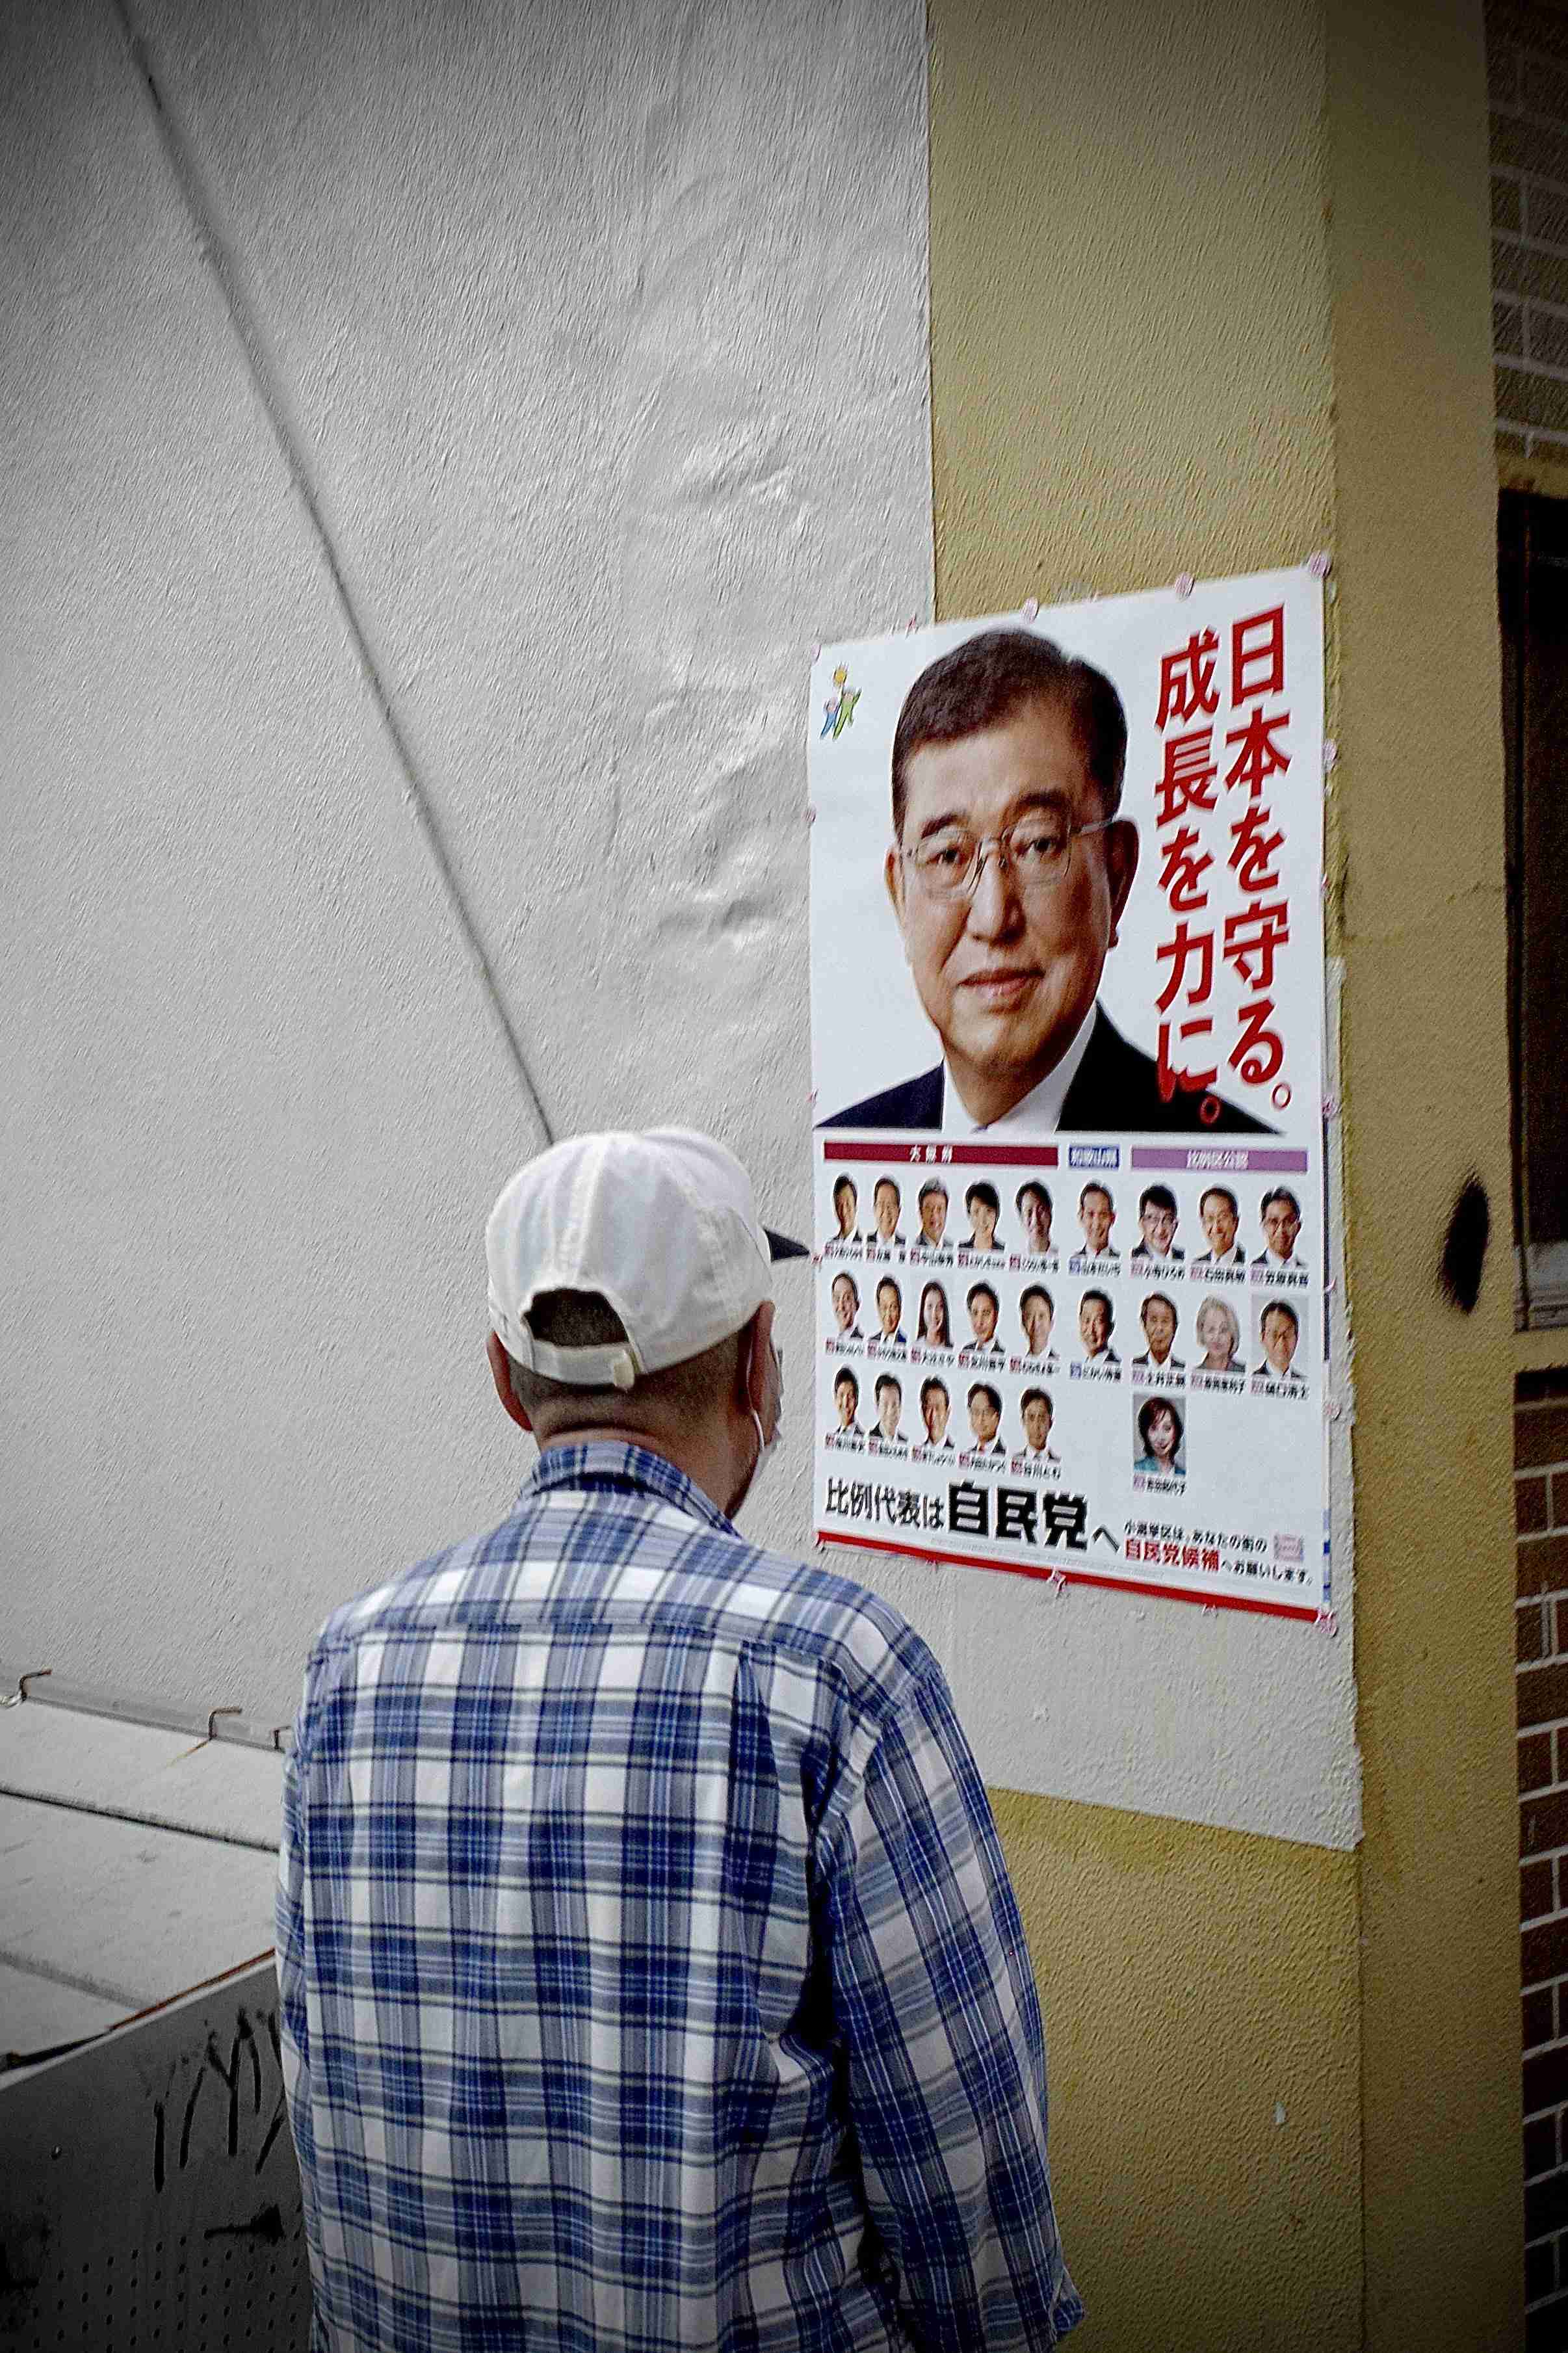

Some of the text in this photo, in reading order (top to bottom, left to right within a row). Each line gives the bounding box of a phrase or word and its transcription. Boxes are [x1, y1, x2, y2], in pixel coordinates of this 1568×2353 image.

[1155, 625, 1220, 1126] 成長を力に。
[1223, 601, 1292, 1111] 日本を守る。
